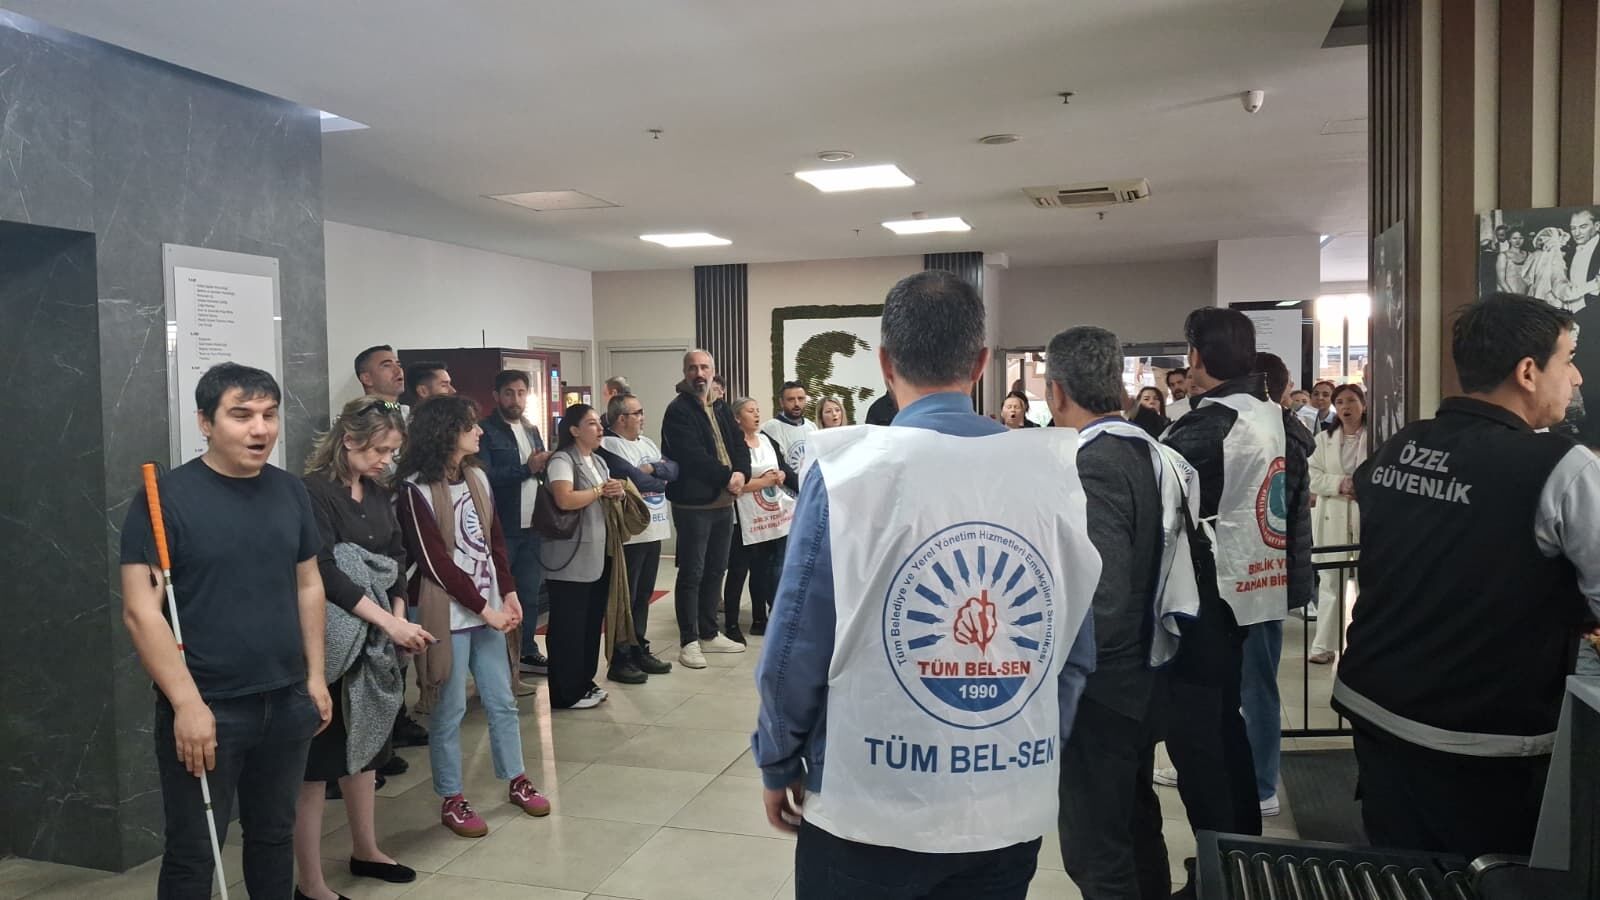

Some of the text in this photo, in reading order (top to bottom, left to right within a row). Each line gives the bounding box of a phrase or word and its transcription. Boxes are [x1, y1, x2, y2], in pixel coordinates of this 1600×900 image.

[1399, 440, 1451, 473] ÖZEL
[1371, 464, 1473, 505] GÜVENLİK
[935, 531, 977, 550] Yönetim
[979, 530, 1026, 556] Hizmetleri
[911, 546, 936, 571] Yerel
[904, 573, 915, 585] ve
[891, 587, 907, 637] Belediye
[894, 641, 907, 667] Tüm
[917, 658, 1031, 676] TÜM BEL-SEN
[959, 684, 998, 699] 1990
[864, 735, 1055, 774] TÜM BEL-SEN
